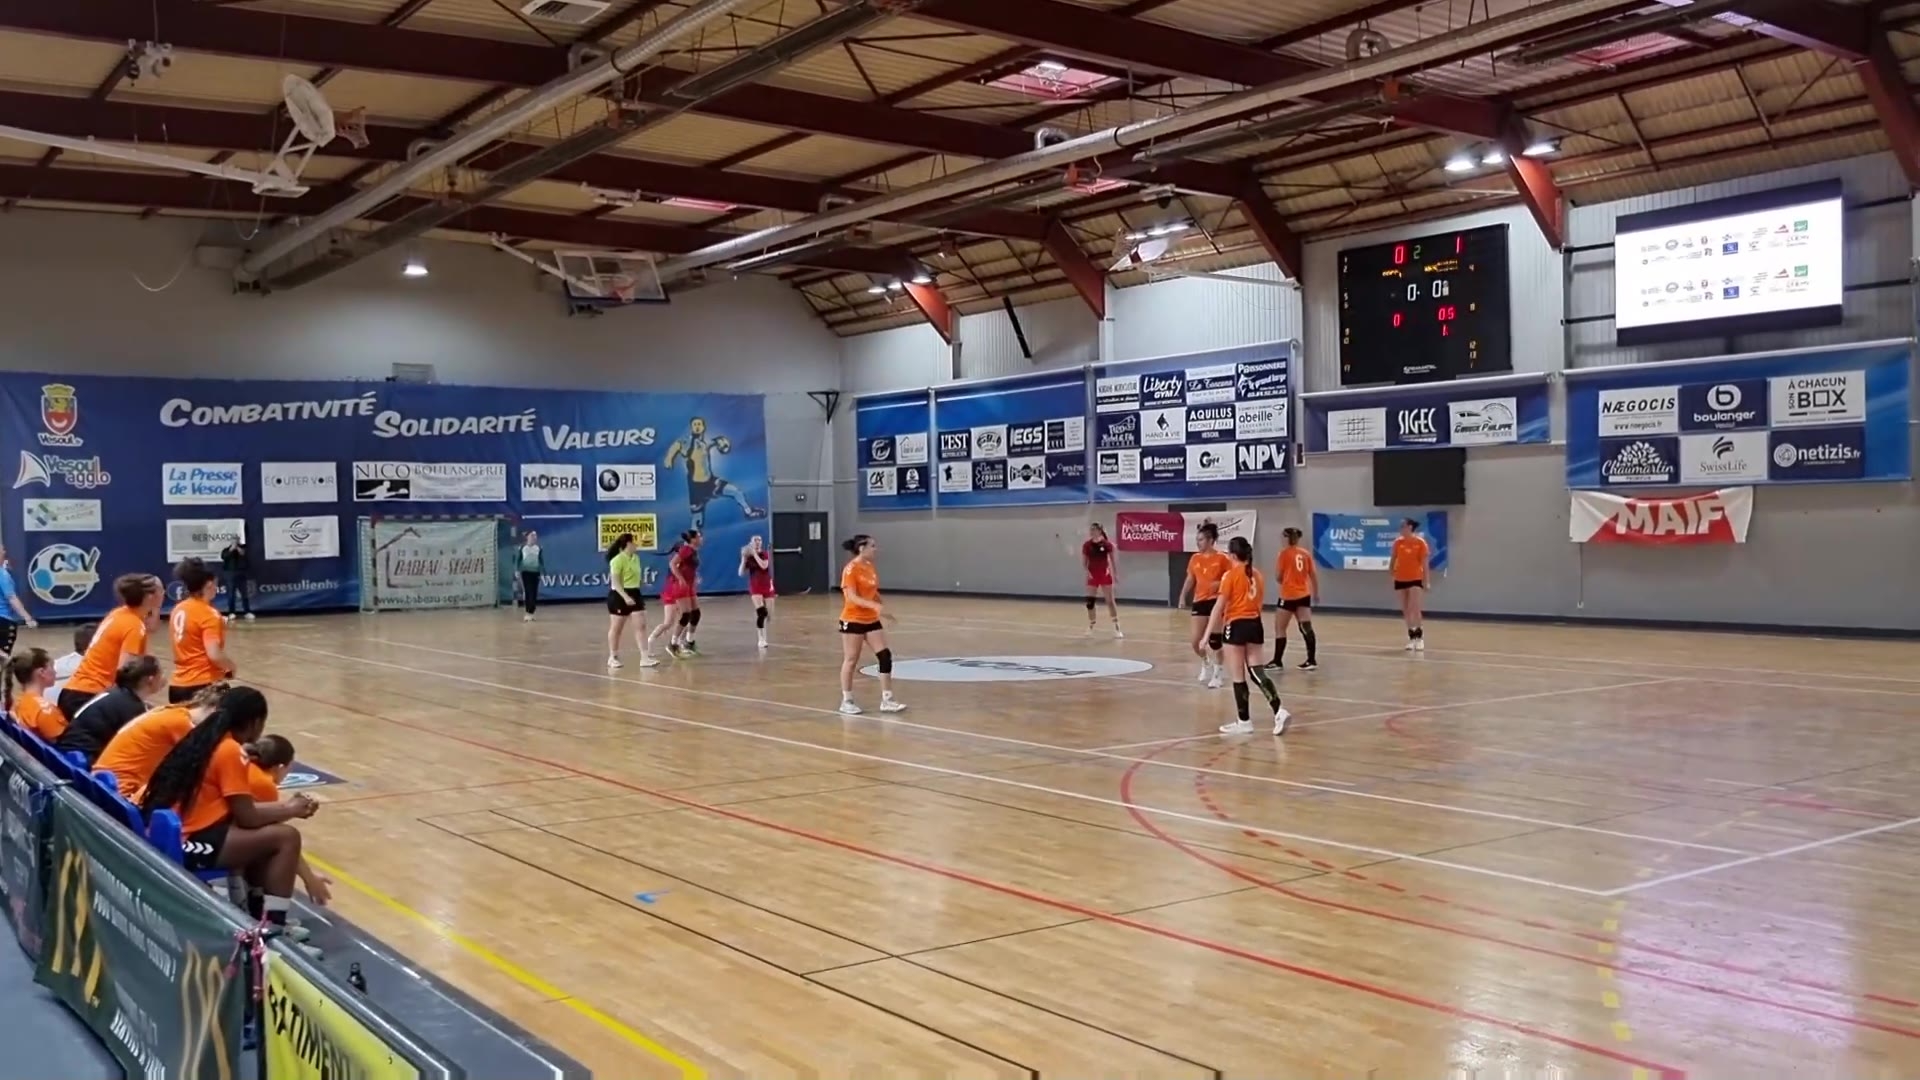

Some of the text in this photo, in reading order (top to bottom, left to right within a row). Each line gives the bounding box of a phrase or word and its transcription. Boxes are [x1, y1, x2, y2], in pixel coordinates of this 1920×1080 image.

[1143, 375, 1182, 397] Liberty
[1798, 376, 1847, 390] CHACUN
[1154, 390, 1173, 399] GYM
[160, 391, 377, 427] COMBATIVITÉ
[1189, 407, 1233, 421] AQUILUS
[1602, 398, 1676, 414] NÆGOCIS
[373, 408, 536, 438] SOLIDARITÉ
[1238, 410, 1274, 424] abeille
[1398, 408, 1437, 435] SIGEC
[1694, 411, 1756, 423] boulanger
[542, 425, 656, 450] VALEURS
[941, 433, 969, 451] L'EST
[1239, 444, 1287, 471] NPV
[1798, 443, 1862, 461] netizis.fr
[44, 455, 99, 474] Vesoul
[355, 463, 411, 478] NICO
[414, 464, 505, 477] BOULANGERIE
[1601, 459, 1674, 476] Chaumartin
[1699, 459, 1748, 472] SwissLife
[65, 472, 112, 489] agglo
[169, 468, 238, 481] La Presse
[524, 474, 580, 490] MOGRA
[169, 481, 238, 495] de Vesoul
[1614, 499, 1725, 535] MAIF
[1296, 554, 1304, 572] 6
[173, 609, 186, 641] 9
